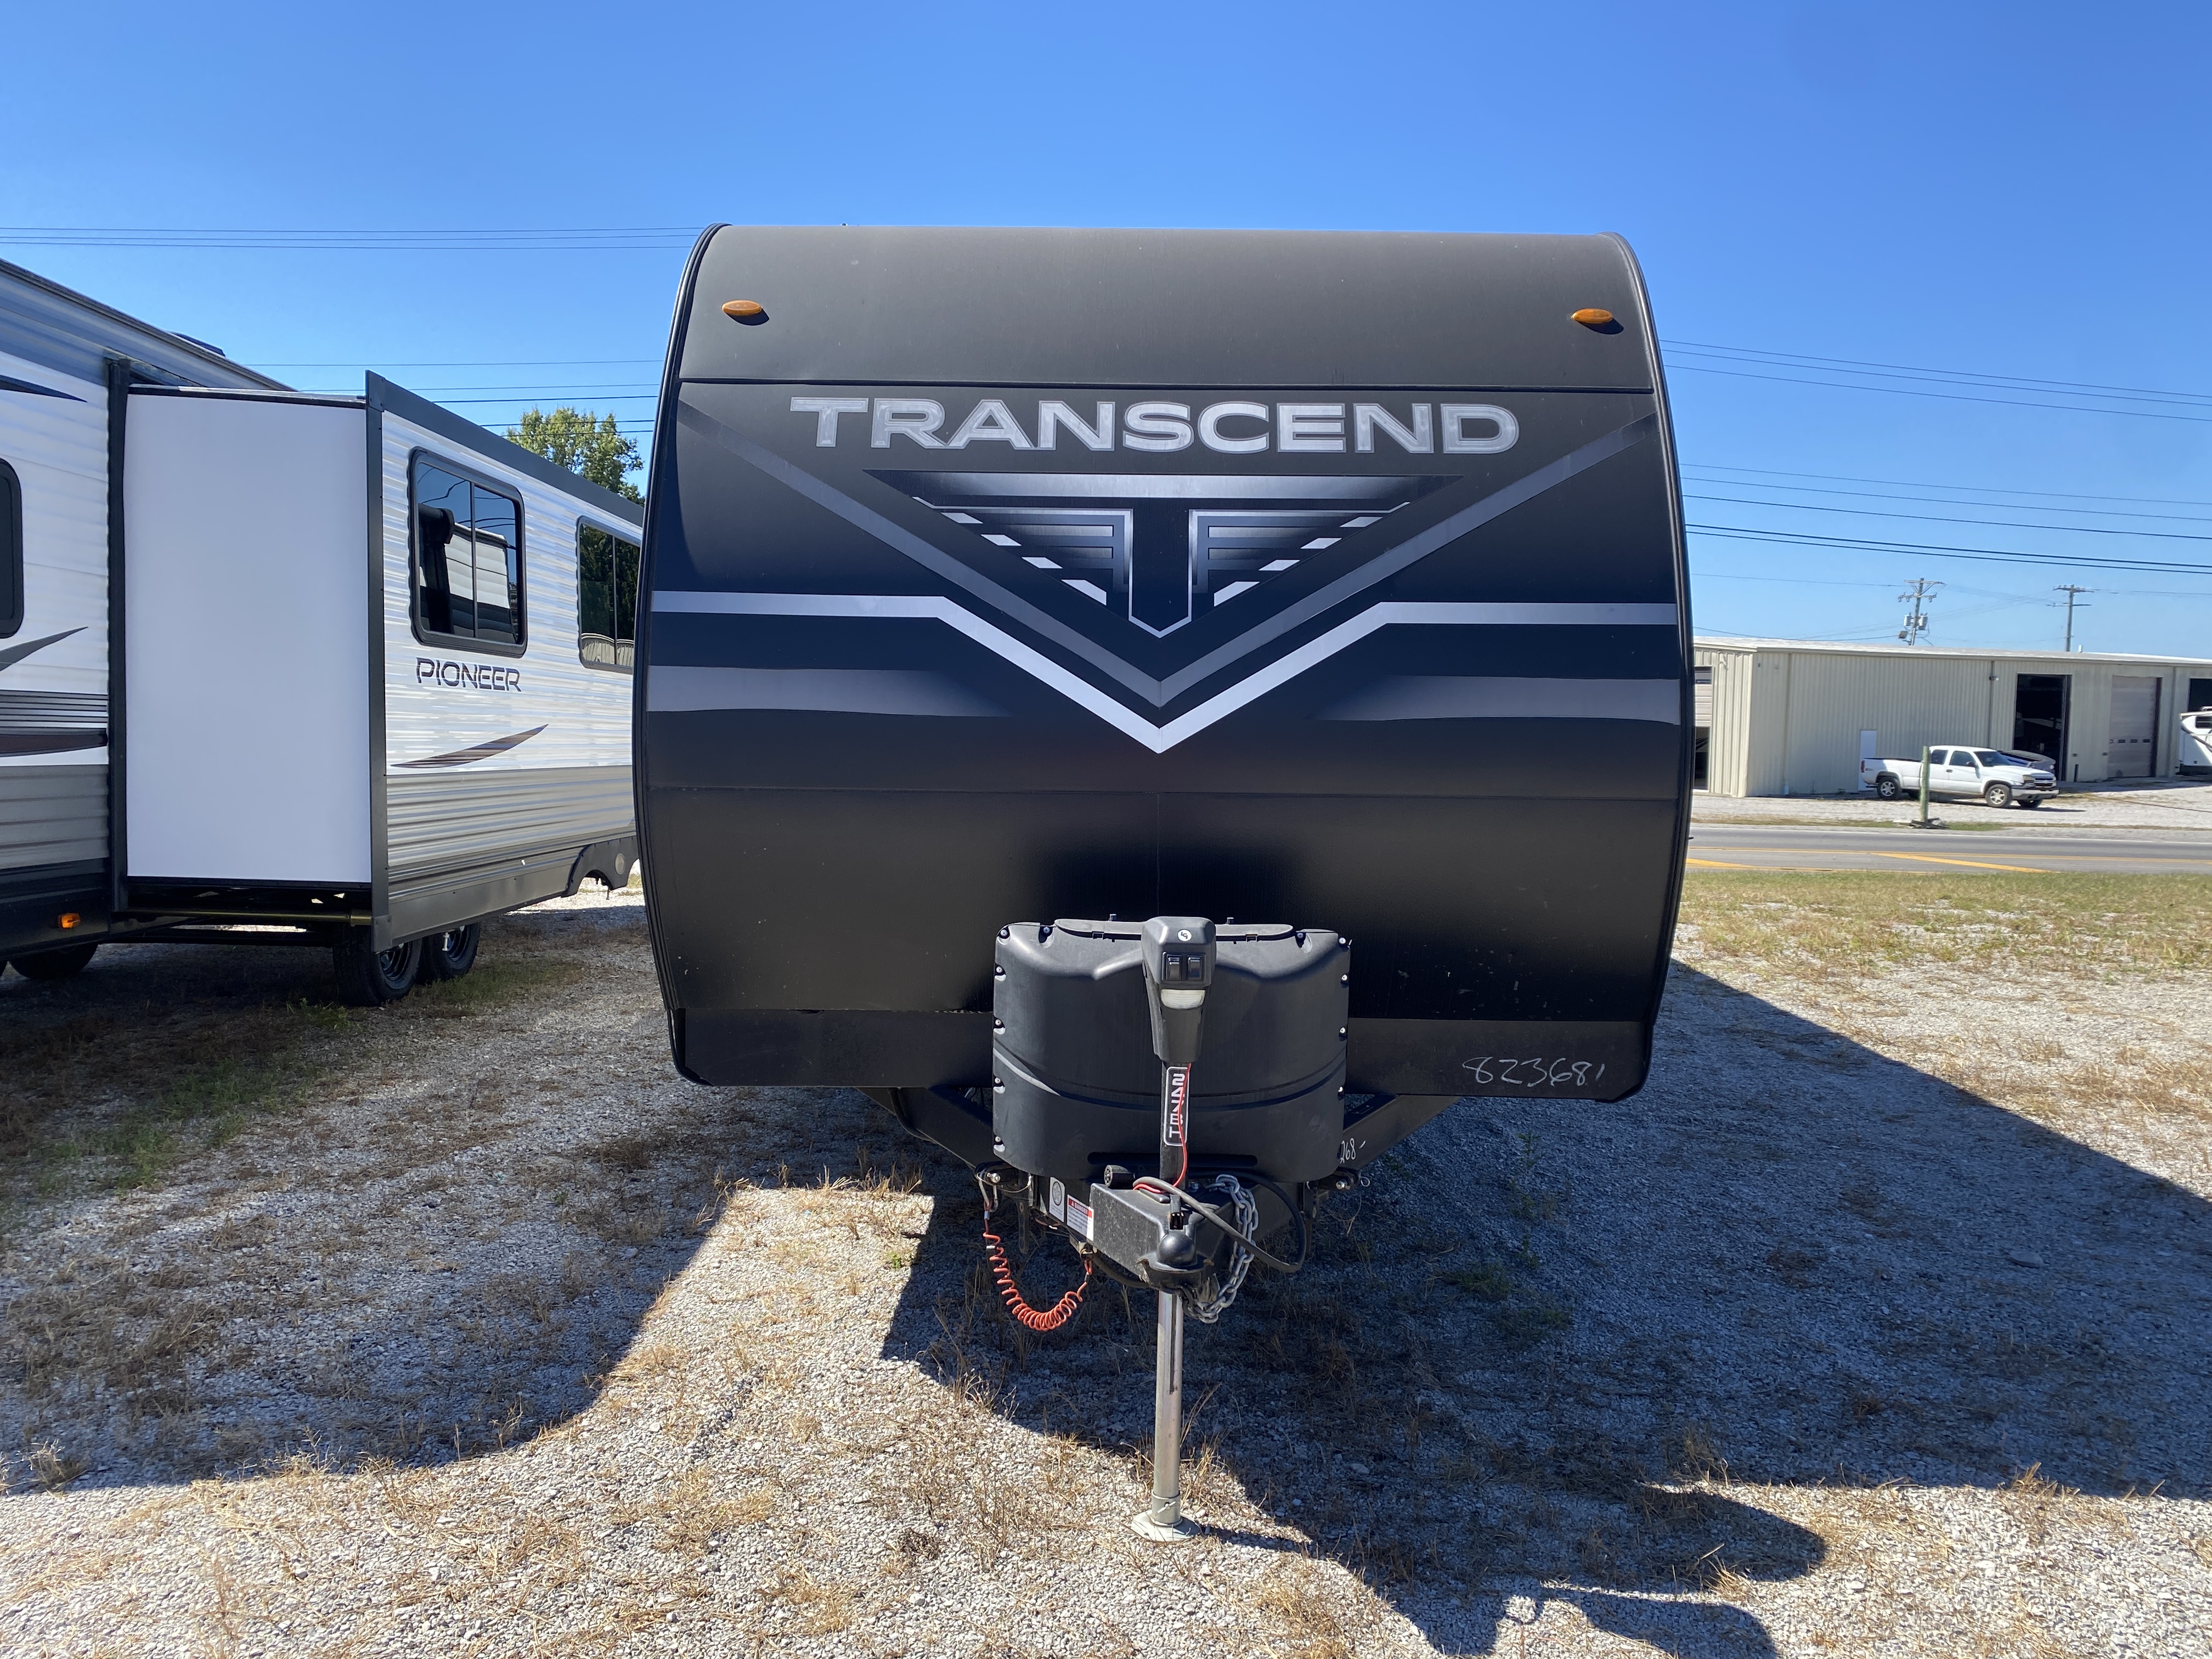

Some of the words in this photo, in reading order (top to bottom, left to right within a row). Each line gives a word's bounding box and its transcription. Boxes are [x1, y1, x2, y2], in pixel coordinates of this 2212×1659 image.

[789, 396, 1520, 454] TRANSCEND
[416, 657, 522, 692] PIONEER
[1462, 1057, 1605, 1087] 823681
